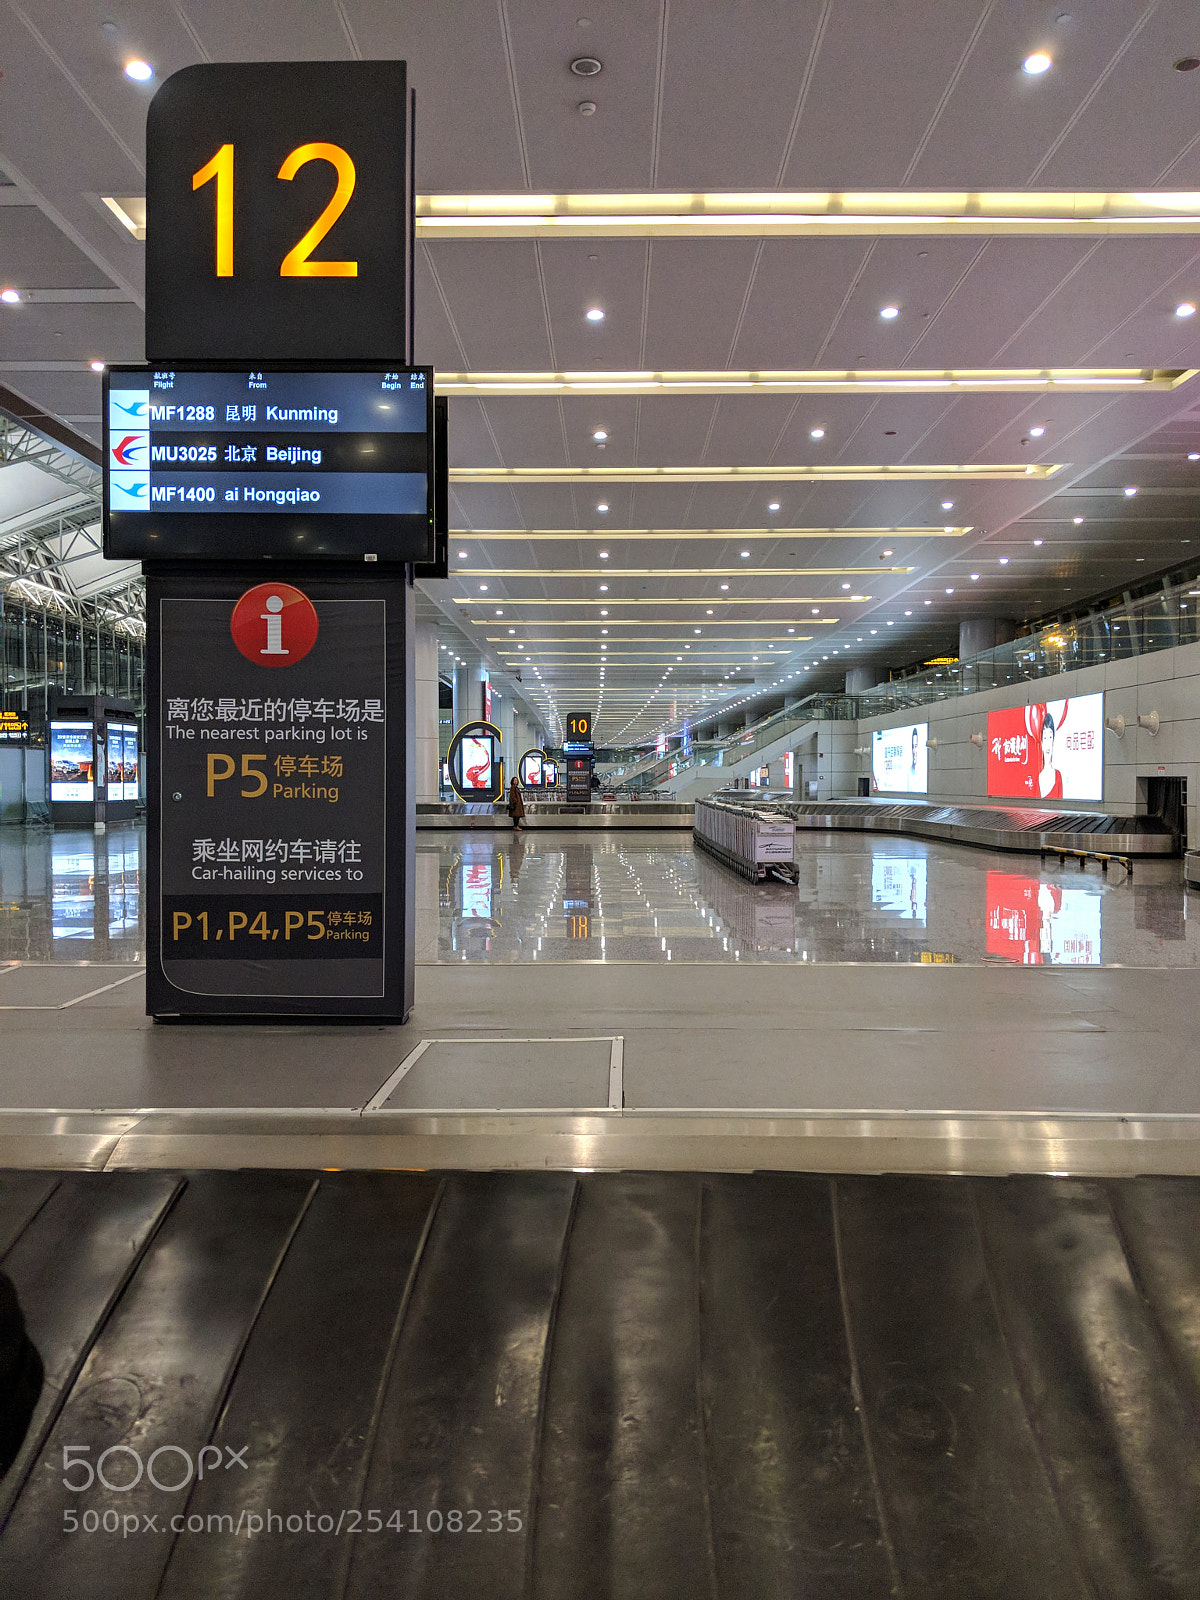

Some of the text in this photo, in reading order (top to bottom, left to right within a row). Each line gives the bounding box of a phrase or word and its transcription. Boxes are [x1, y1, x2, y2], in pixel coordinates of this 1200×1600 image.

[192, 142, 358, 277] 12
[153, 381, 174, 389] Flight
[248, 381, 267, 389] From
[381, 381, 401, 390] Begin
[410, 381, 424, 389] End
[151, 404, 338, 424] MF1288 昆明 Kunming
[151, 445, 322, 465] MU3025 北京 Beijing
[151, 487, 321, 505] MF1400 ai Hongqiao
[166, 698, 385, 723] 离您最近的停车场是
[166, 725, 368, 743] The nearest parking lot is
[570, 719, 588, 734] 10
[274, 755, 343, 777] 停车场
[206, 753, 268, 798] P5
[273, 783, 339, 802] Parking
[192, 838, 362, 864] 乘坐网约车请往
[192, 866, 363, 884] Car-hailing services to
[327, 911, 372, 926] 停车场
[326, 929, 370, 942] Parking
